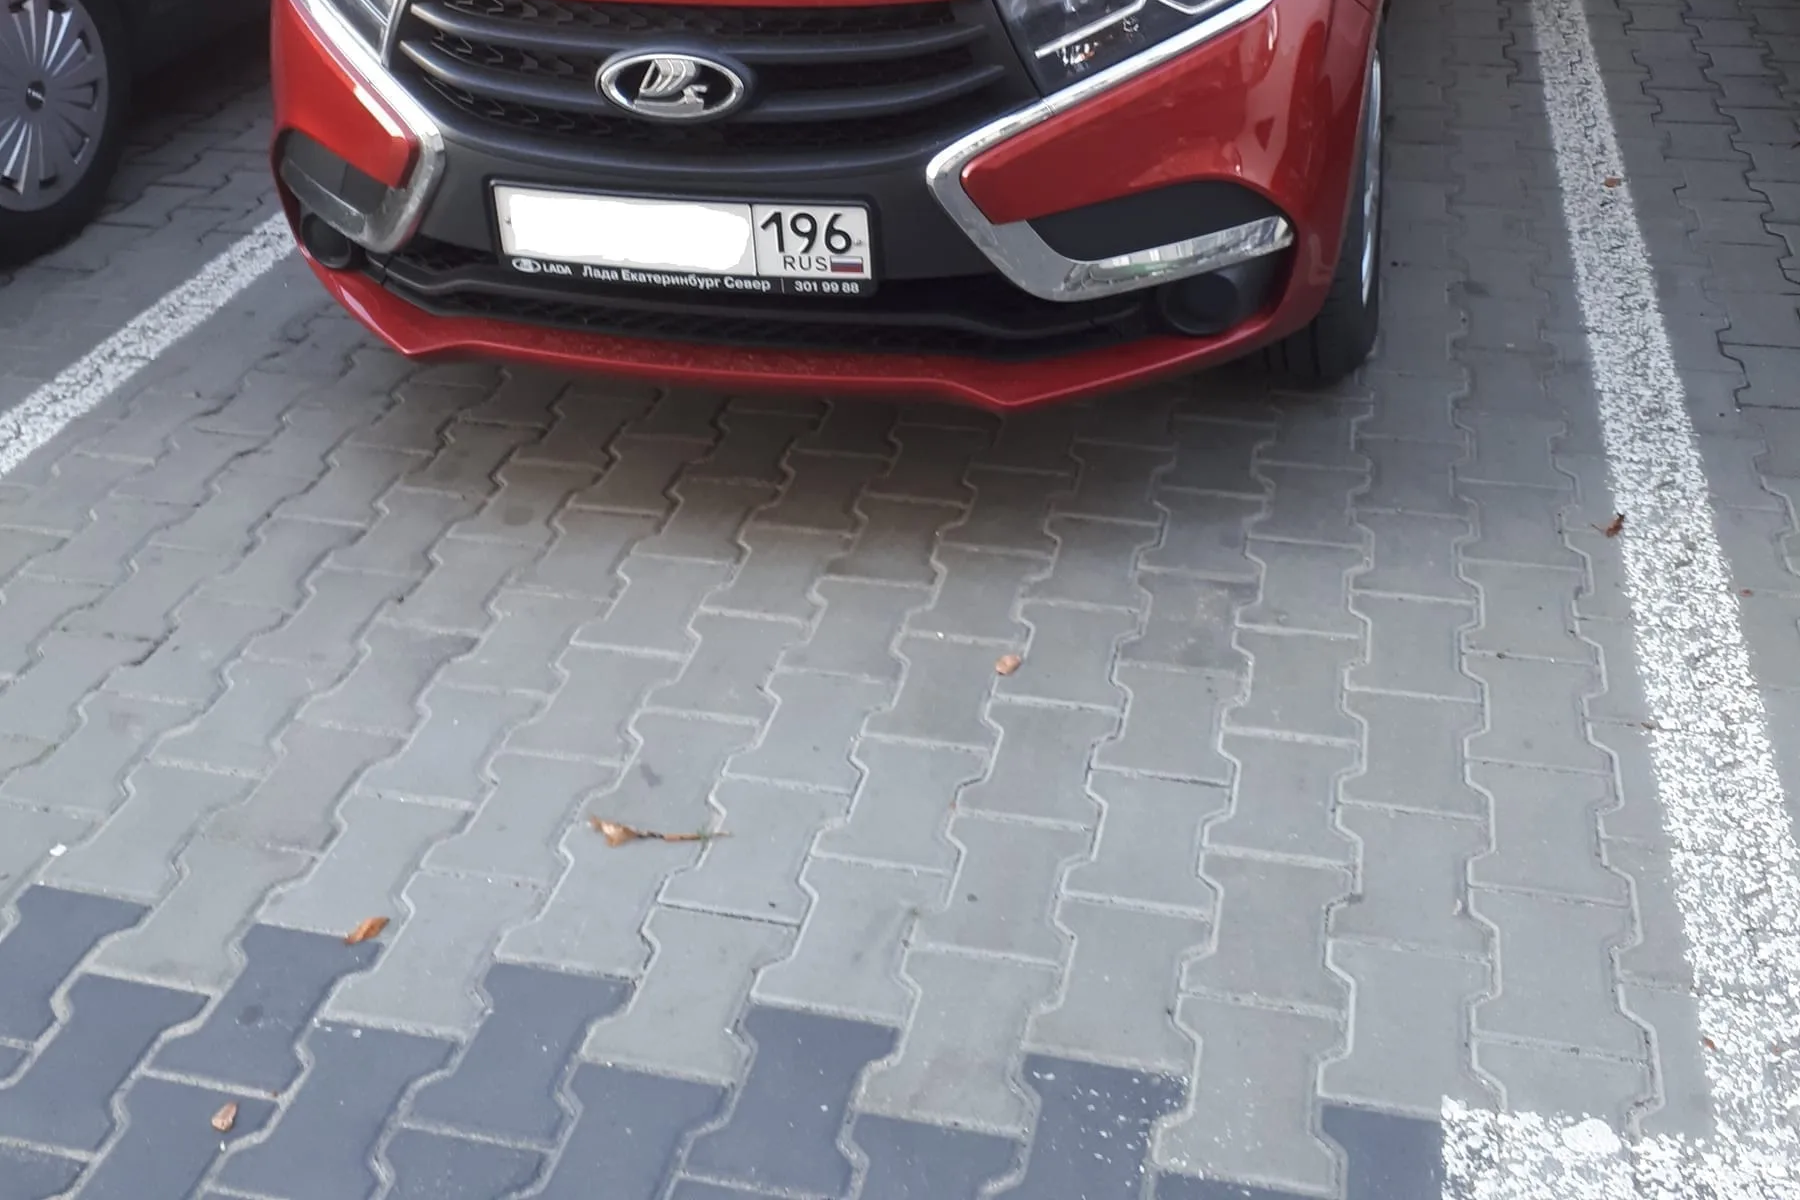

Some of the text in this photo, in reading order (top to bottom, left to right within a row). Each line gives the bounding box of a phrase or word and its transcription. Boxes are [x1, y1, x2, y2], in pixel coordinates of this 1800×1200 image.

[760, 211, 852, 255] 196
[542, 262, 573, 276] LADA
[783, 255, 828, 272] RUS
[582, 265, 772, 292] Лада Екатеринбург Север
[794, 281, 860, 294] 301 99 88
